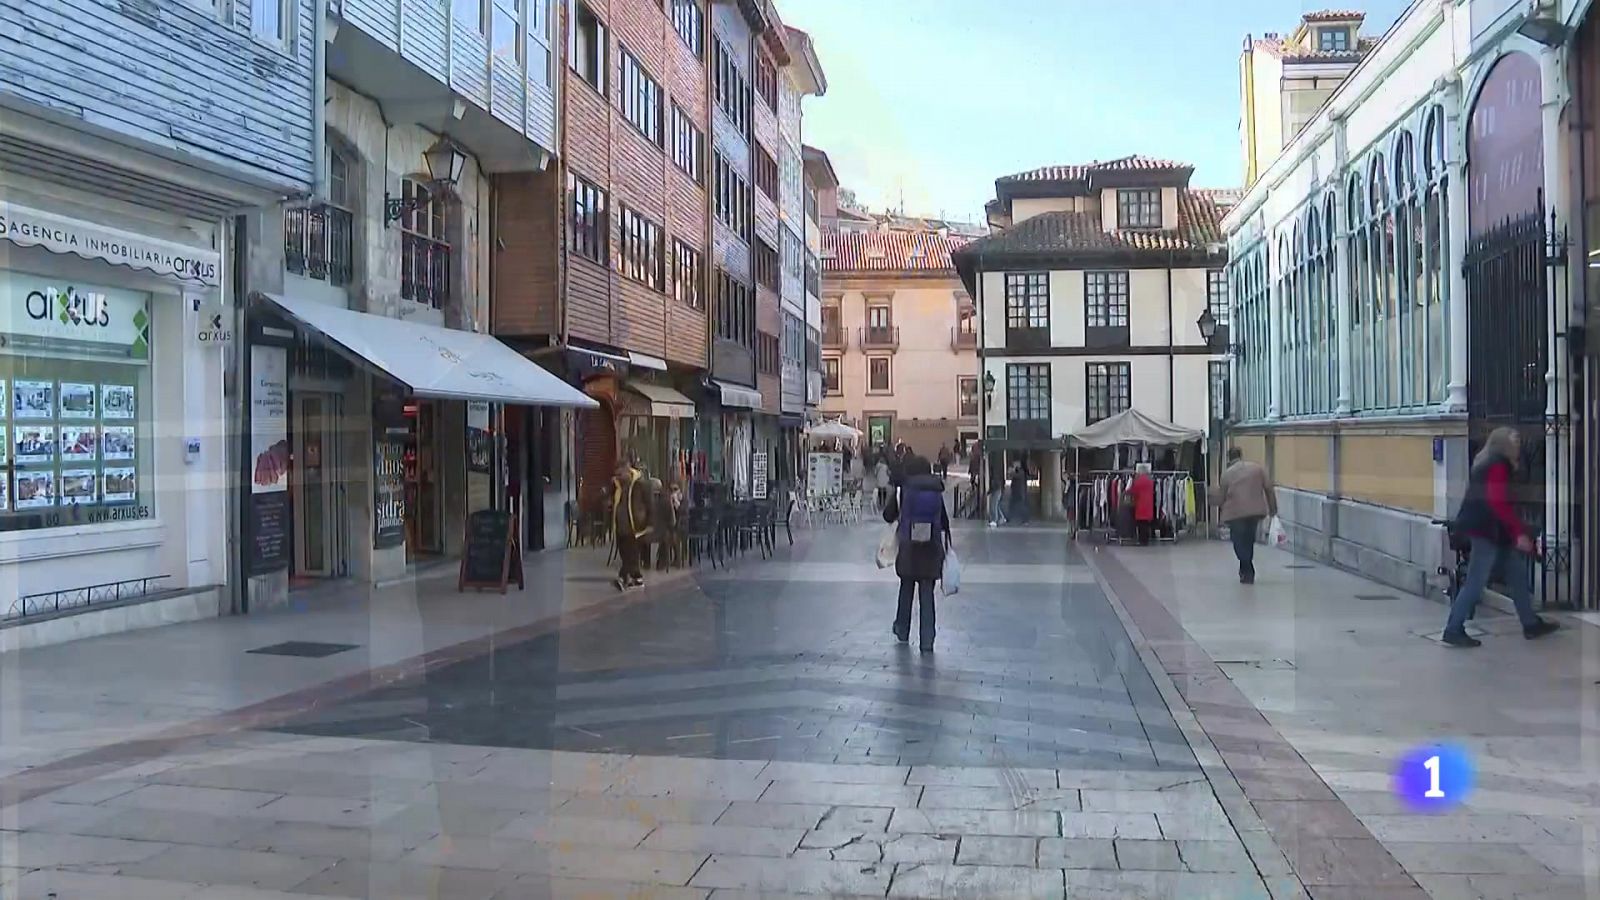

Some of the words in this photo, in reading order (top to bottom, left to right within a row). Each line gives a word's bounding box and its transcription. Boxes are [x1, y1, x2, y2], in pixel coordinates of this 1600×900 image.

[10, 221, 78, 246] AGENCIA
[85, 237, 172, 267] INMOBILIARIA
[173, 256, 215, 279] arxus
[198, 330, 231, 342] arxus
[88, 504, 149, 524] www.arxus.es
[377, 494, 404, 519] sidra
